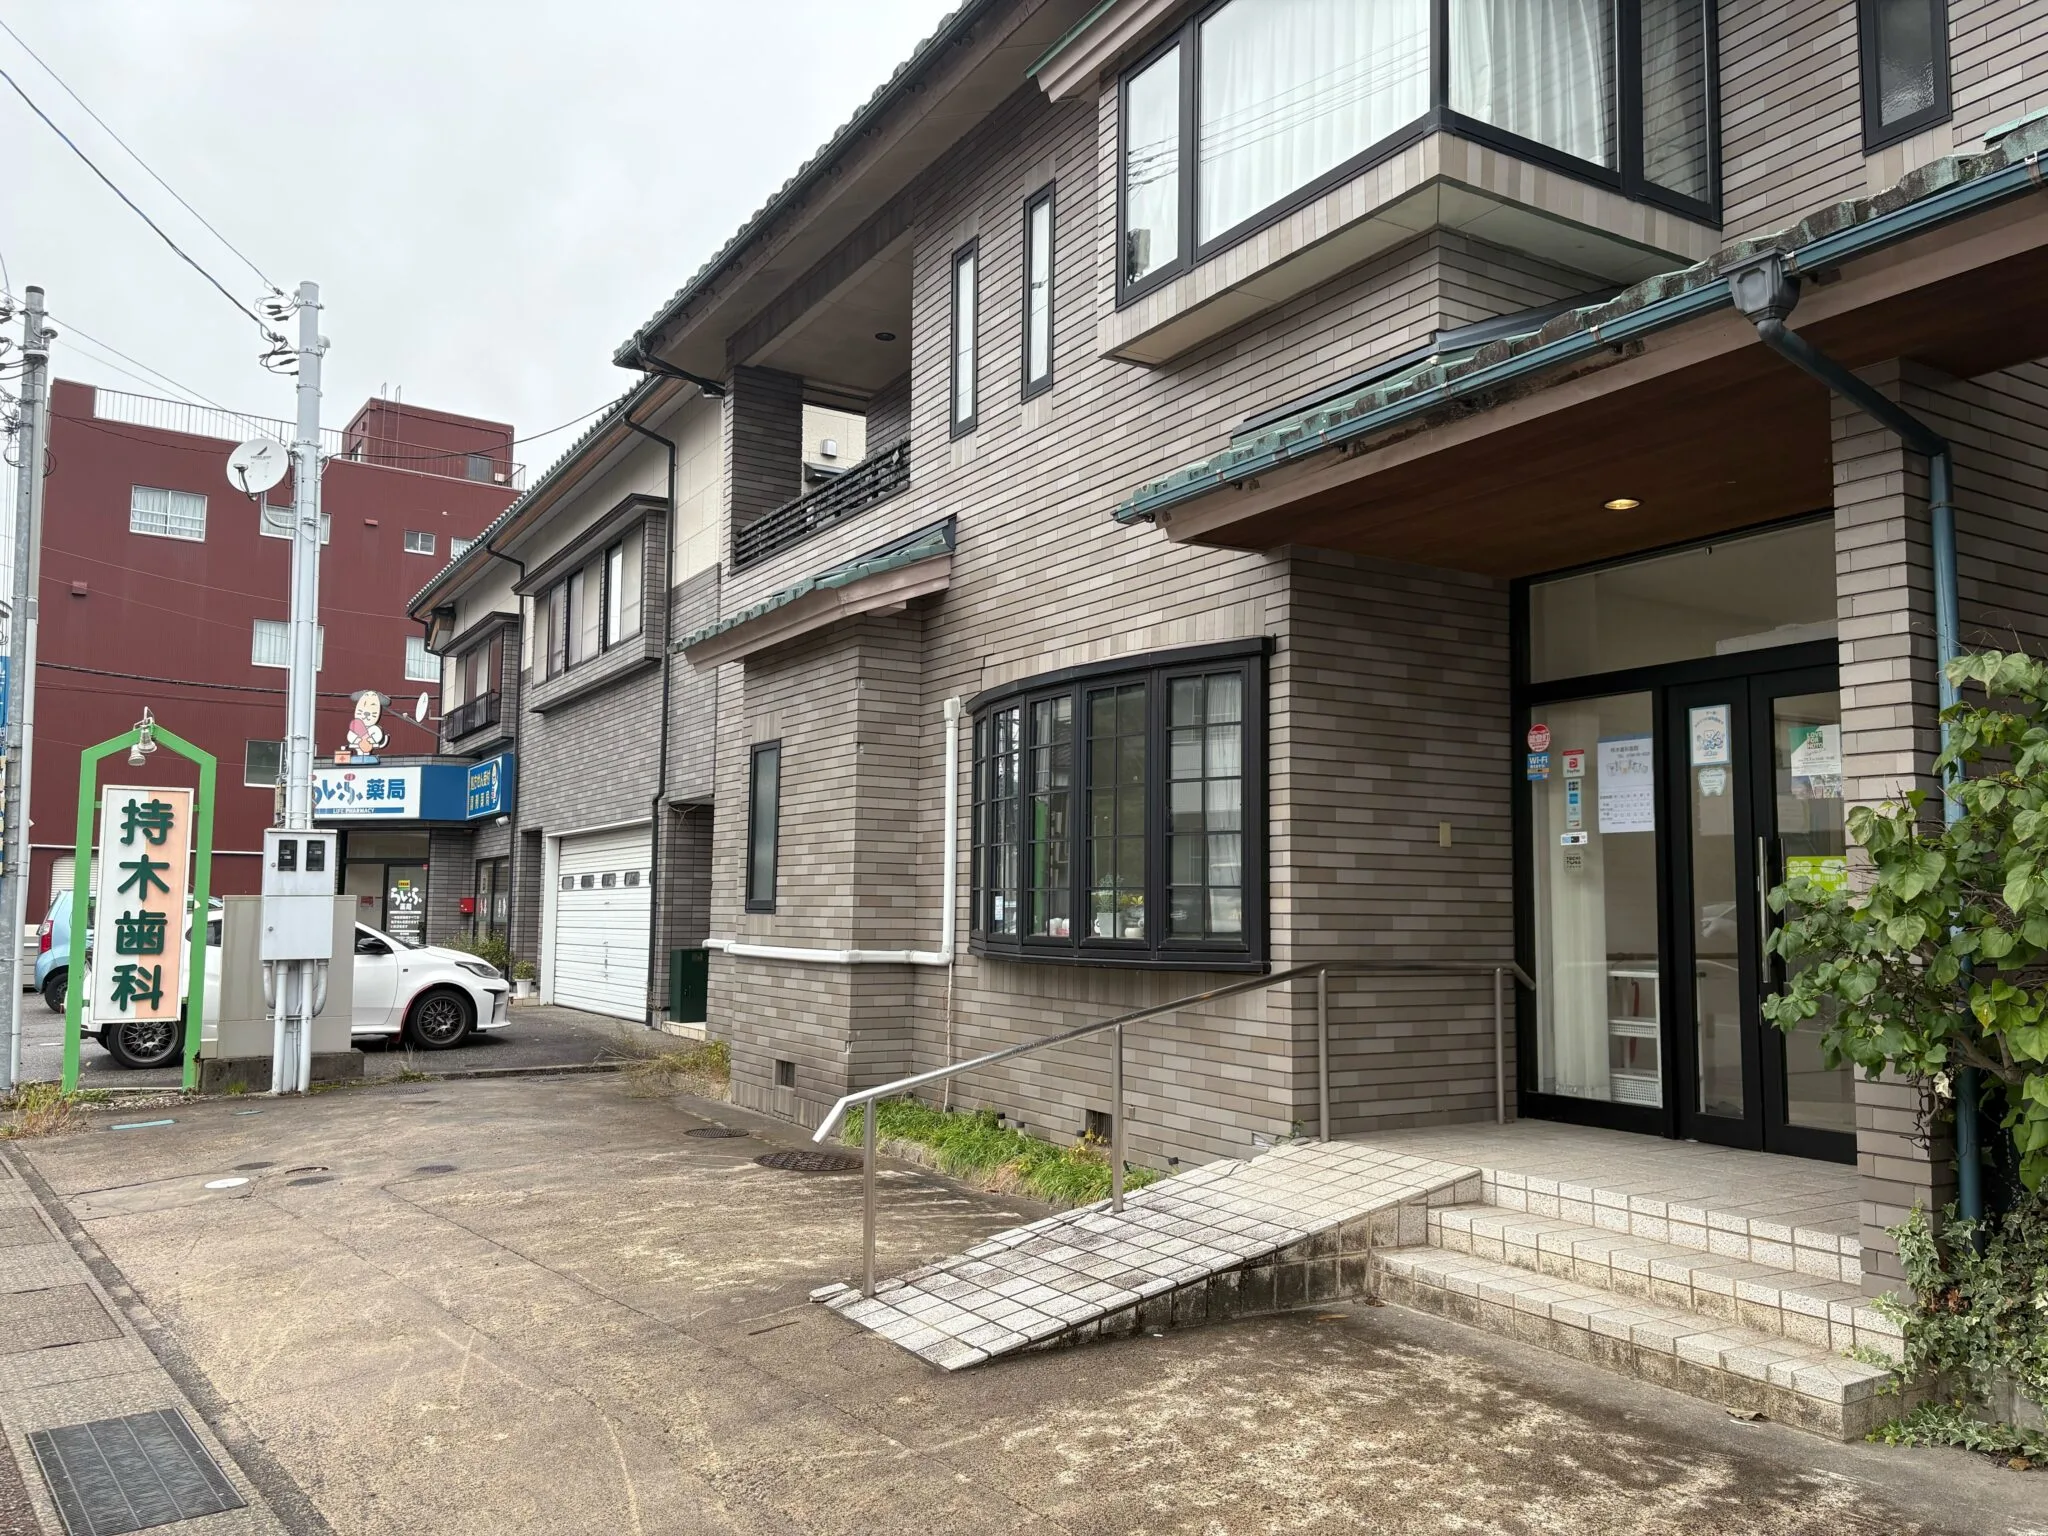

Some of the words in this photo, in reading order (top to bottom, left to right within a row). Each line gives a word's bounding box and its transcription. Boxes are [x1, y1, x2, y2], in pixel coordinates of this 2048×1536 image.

[1529, 756, 1548, 765] Wi-Fi
[110, 798, 175, 1012] 持木歯科
[390, 887, 423, 906] らいふ
